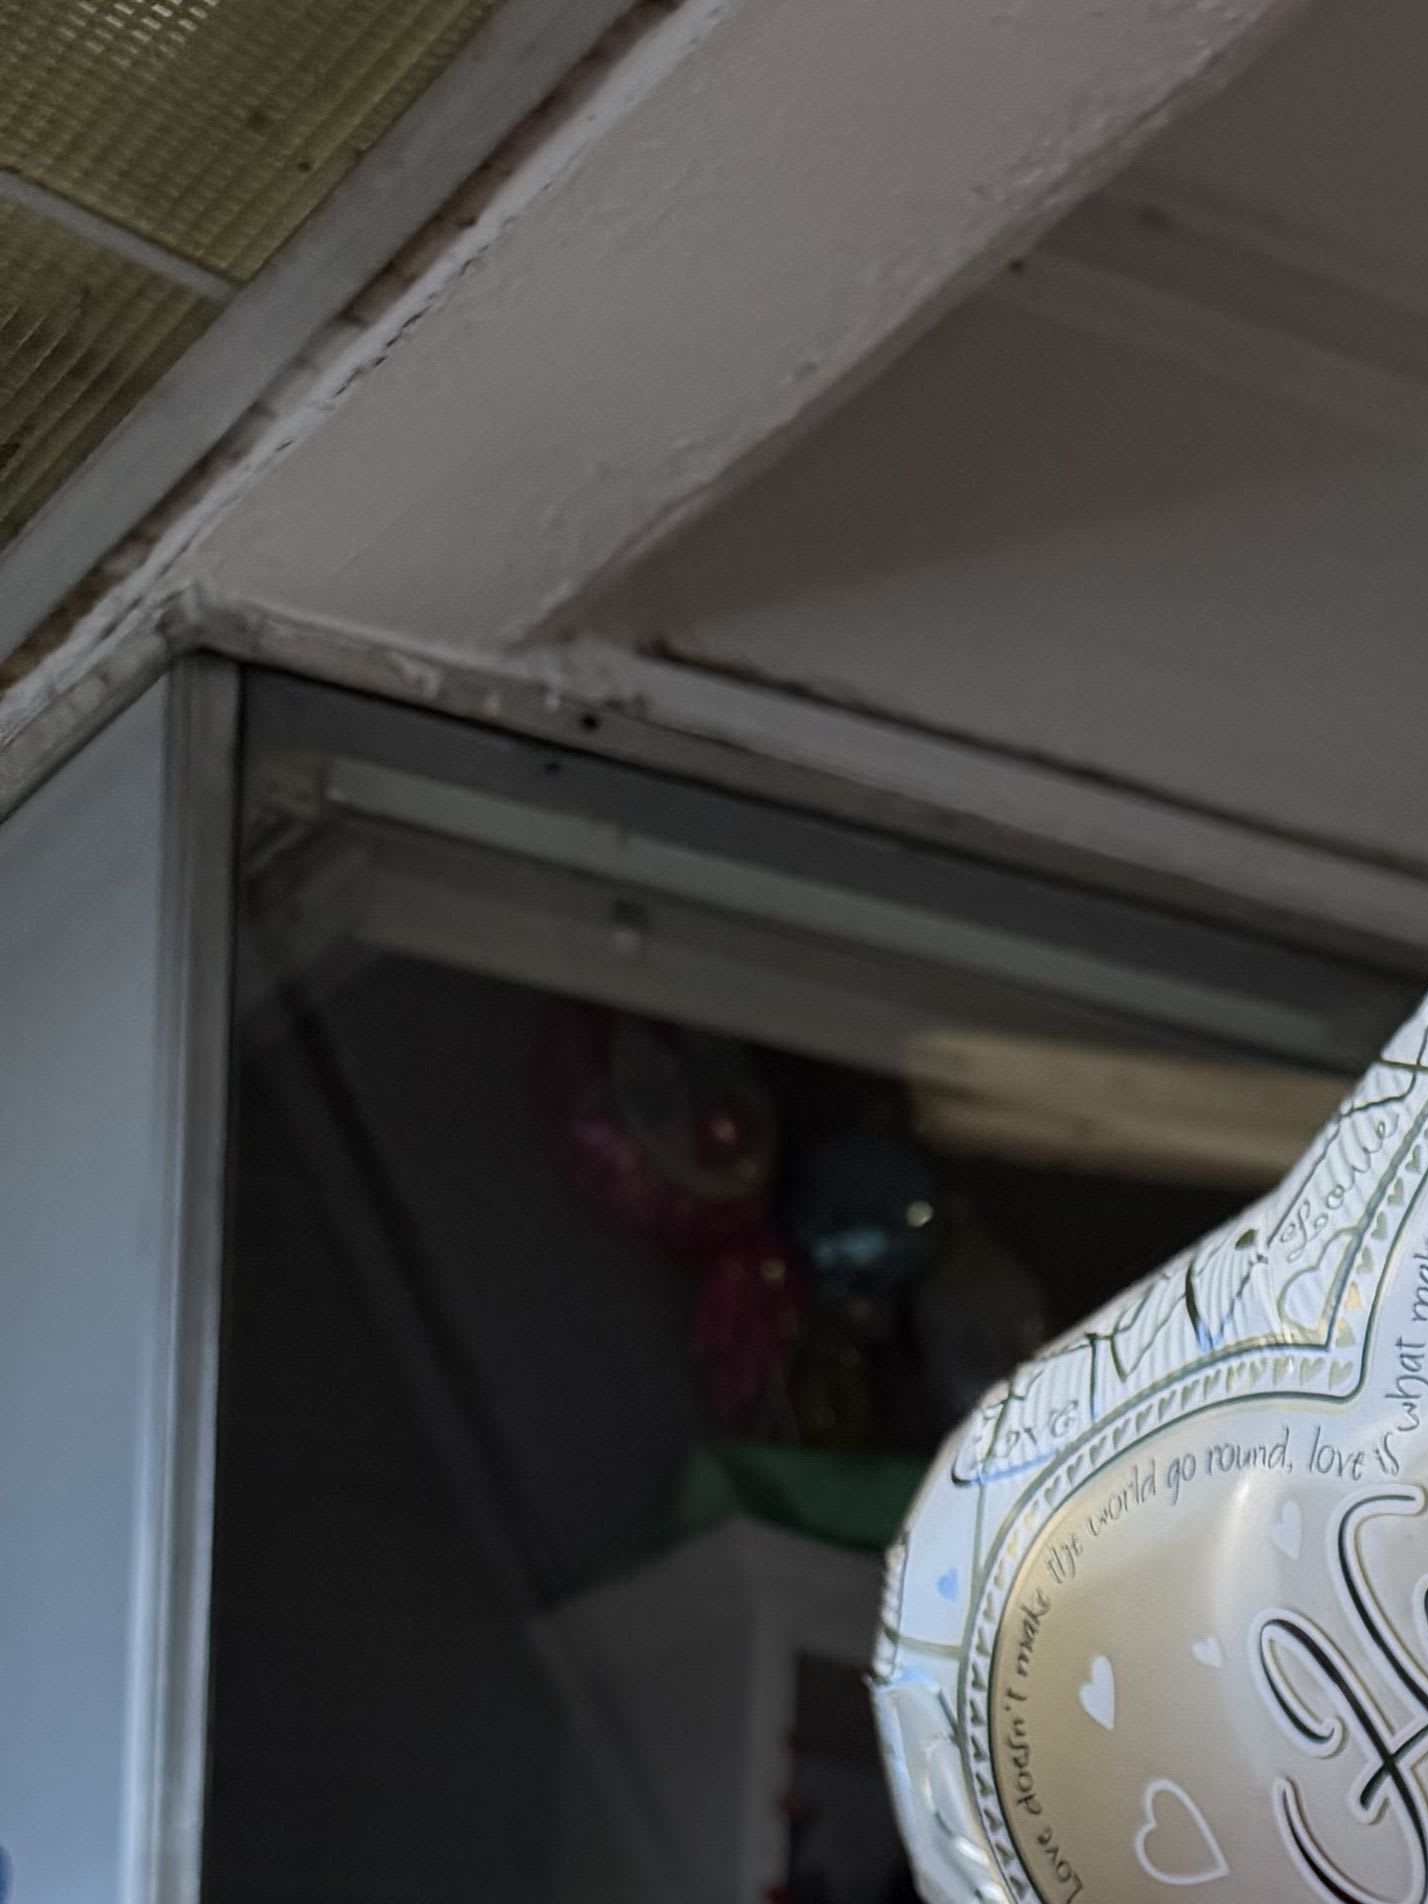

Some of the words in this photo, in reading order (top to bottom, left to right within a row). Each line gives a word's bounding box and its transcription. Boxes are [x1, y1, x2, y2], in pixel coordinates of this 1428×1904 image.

[1018, 1590, 1051, 1678] make
[1045, 1541, 1083, 1585] the
[1088, 1465, 1156, 1537] world
[1166, 1451, 1197, 1506] go
[1308, 1425, 1364, 1481] love
[1377, 1431, 1401, 1476] is
